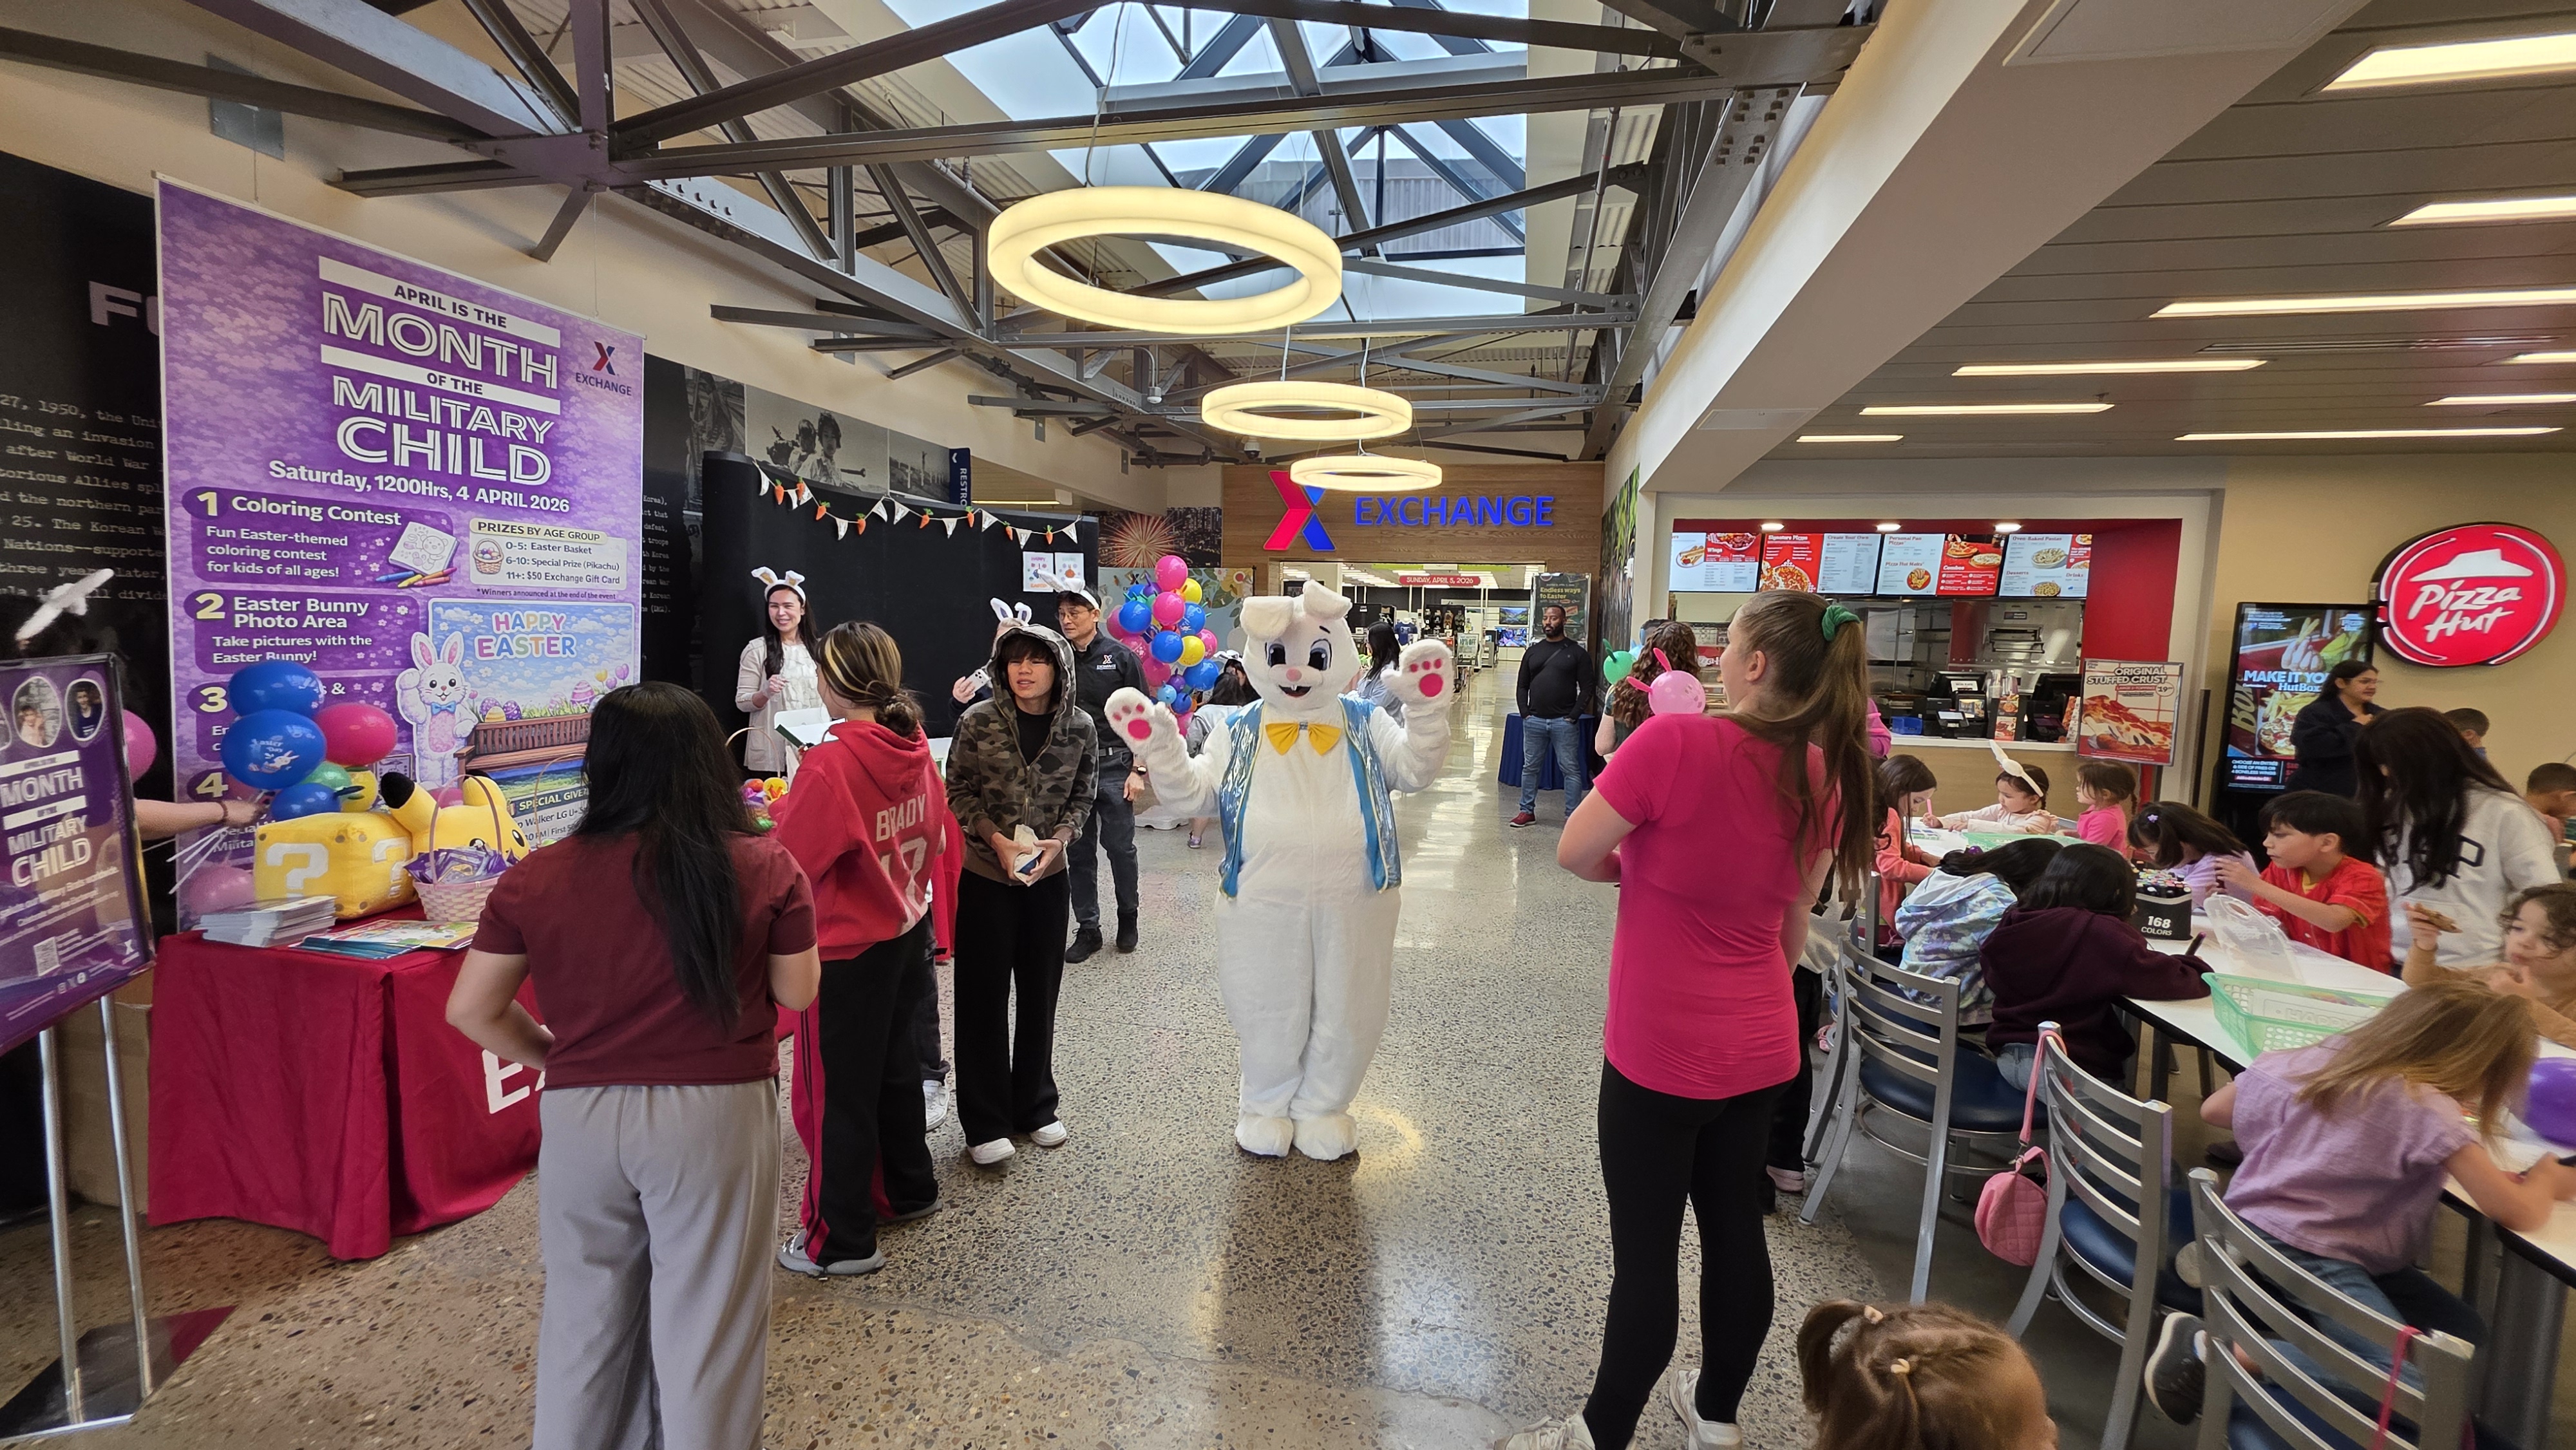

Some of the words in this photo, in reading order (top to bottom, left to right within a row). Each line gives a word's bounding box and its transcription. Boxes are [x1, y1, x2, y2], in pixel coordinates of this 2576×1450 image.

[394, 285, 446, 310] APRIL
[452, 301, 468, 316] IS
[473, 309, 507, 328] THE
[323, 291, 558, 389] MONTH
[426, 372, 446, 386] OF
[450, 377, 483, 395] THE
[575, 373, 632, 397] EXCHANGE
[39, 400, 86, 419] 1950,
[96, 410, 123, 423] the
[334, 375, 554, 444] MILITARY
[52, 428, 75, 438] an
[82, 431, 155, 449] invasion
[6, 445, 58, 459] after
[65, 450, 115, 466] World
[122, 457, 149, 469] War
[337, 417, 551, 485] CHILD
[73, 475, 129, 490] Allies
[269, 460, 372, 492] Saturday,
[374, 475, 452, 502] 1200Hrs,
[456, 487, 469, 500] 4
[475, 489, 527, 508] APRIL
[530, 496, 570, 513] 2026
[17, 492, 49, 504] the
[56, 498, 131, 513] northern
[197, 491, 218, 516] 1
[232, 496, 323, 522] Coloring
[328, 506, 402, 525] Contest
[1355, 495, 1555, 526] EXCHANGE
[52, 518, 82, 530] The
[90, 521, 146, 534] Korean
[206, 525, 236, 539] Fun
[240, 528, 348, 547] Easter-themed
[478, 522, 524, 534] PRIZES
[527, 527, 541, 536] BY
[544, 529, 565, 538] AGE
[568, 531, 600, 541] GROUP
[207, 544, 271, 561] coloring
[274, 549, 327, 561] contest
[506, 541, 527, 551] 0-5:
[531, 542, 562, 552] Easter
[564, 545, 592, 554] Basket
[207, 561, 231, 572] for
[233, 561, 263, 574] kids
[267, 564, 283, 575] of
[285, 565, 301, 576] all
[304, 567, 339, 579] ages!
[506, 557, 530, 565] 6-10:
[531, 558, 561, 567] Special
[583, 560, 620, 572] (Pikachu)
[506, 572, 525, 580] 11+:
[527, 571, 542, 581] $50
[545, 572, 583, 584] Exchange
[585, 574, 600, 583] Gift
[601, 575, 620, 585] Card
[1406, 576, 1431, 585] SUNDAY,
[195, 593, 225, 619] 2
[234, 597, 301, 612] Easter
[307, 599, 370, 616] Bunny
[2407, 579, 2523, 620] Pizza
[234, 614, 299, 628] Photo
[302, 616, 348, 628] Area
[494, 613, 565, 632] HAPPY
[2423, 607, 2515, 643] Hut
[213, 636, 250, 646] Take
[252, 636, 312, 649] pictures
[315, 636, 346, 646] with
[349, 636, 373, 646] the
[477, 636, 576, 658] EASTER
[213, 652, 263, 663] Easter
[2087, 675, 2130, 684] STUFFED
[2130, 675, 2167, 684] CRUST
[2114, 667, 2166, 675] ORIGINAL
[2244, 670, 2286, 683] MAKE
[2288, 672, 2301, 683] IT
[199, 686, 228, 713] 3
[0, 767, 84, 808] MONTH
[196, 773, 229, 798] 4
[519, 794, 562, 811] SPECIAL
[556, 810, 568, 820] LG
[876, 794, 926, 842] BRADY
[8, 814, 88, 856] MILITARY
[12, 838, 91, 887] CHILD
[2141, 927, 2173, 936] COLORS
[2148, 916, 2172, 929] 168
